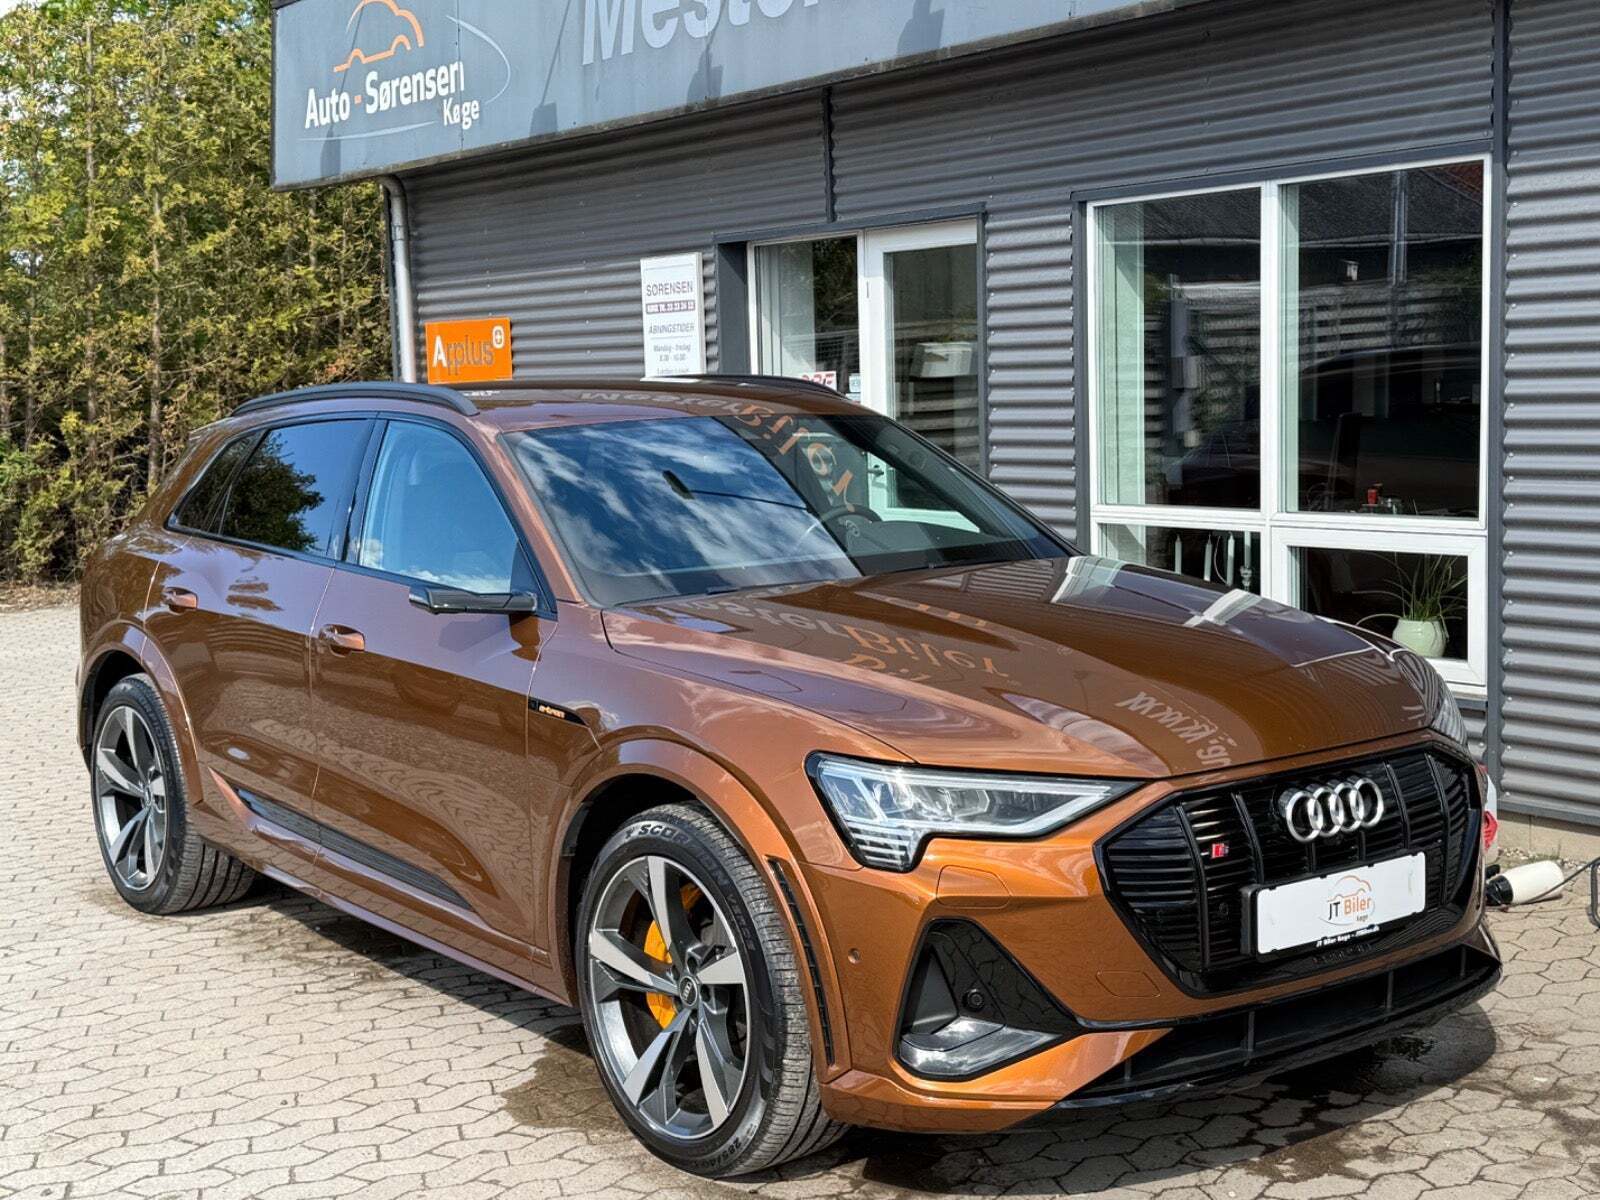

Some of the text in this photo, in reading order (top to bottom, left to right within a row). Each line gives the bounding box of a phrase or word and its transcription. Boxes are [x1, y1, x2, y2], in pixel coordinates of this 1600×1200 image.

[305, 88, 350, 128] Auto
[365, 61, 464, 114] Sørensen
[443, 98, 480, 130] Køge
[1328, 896, 1372, 920] JT Biler
